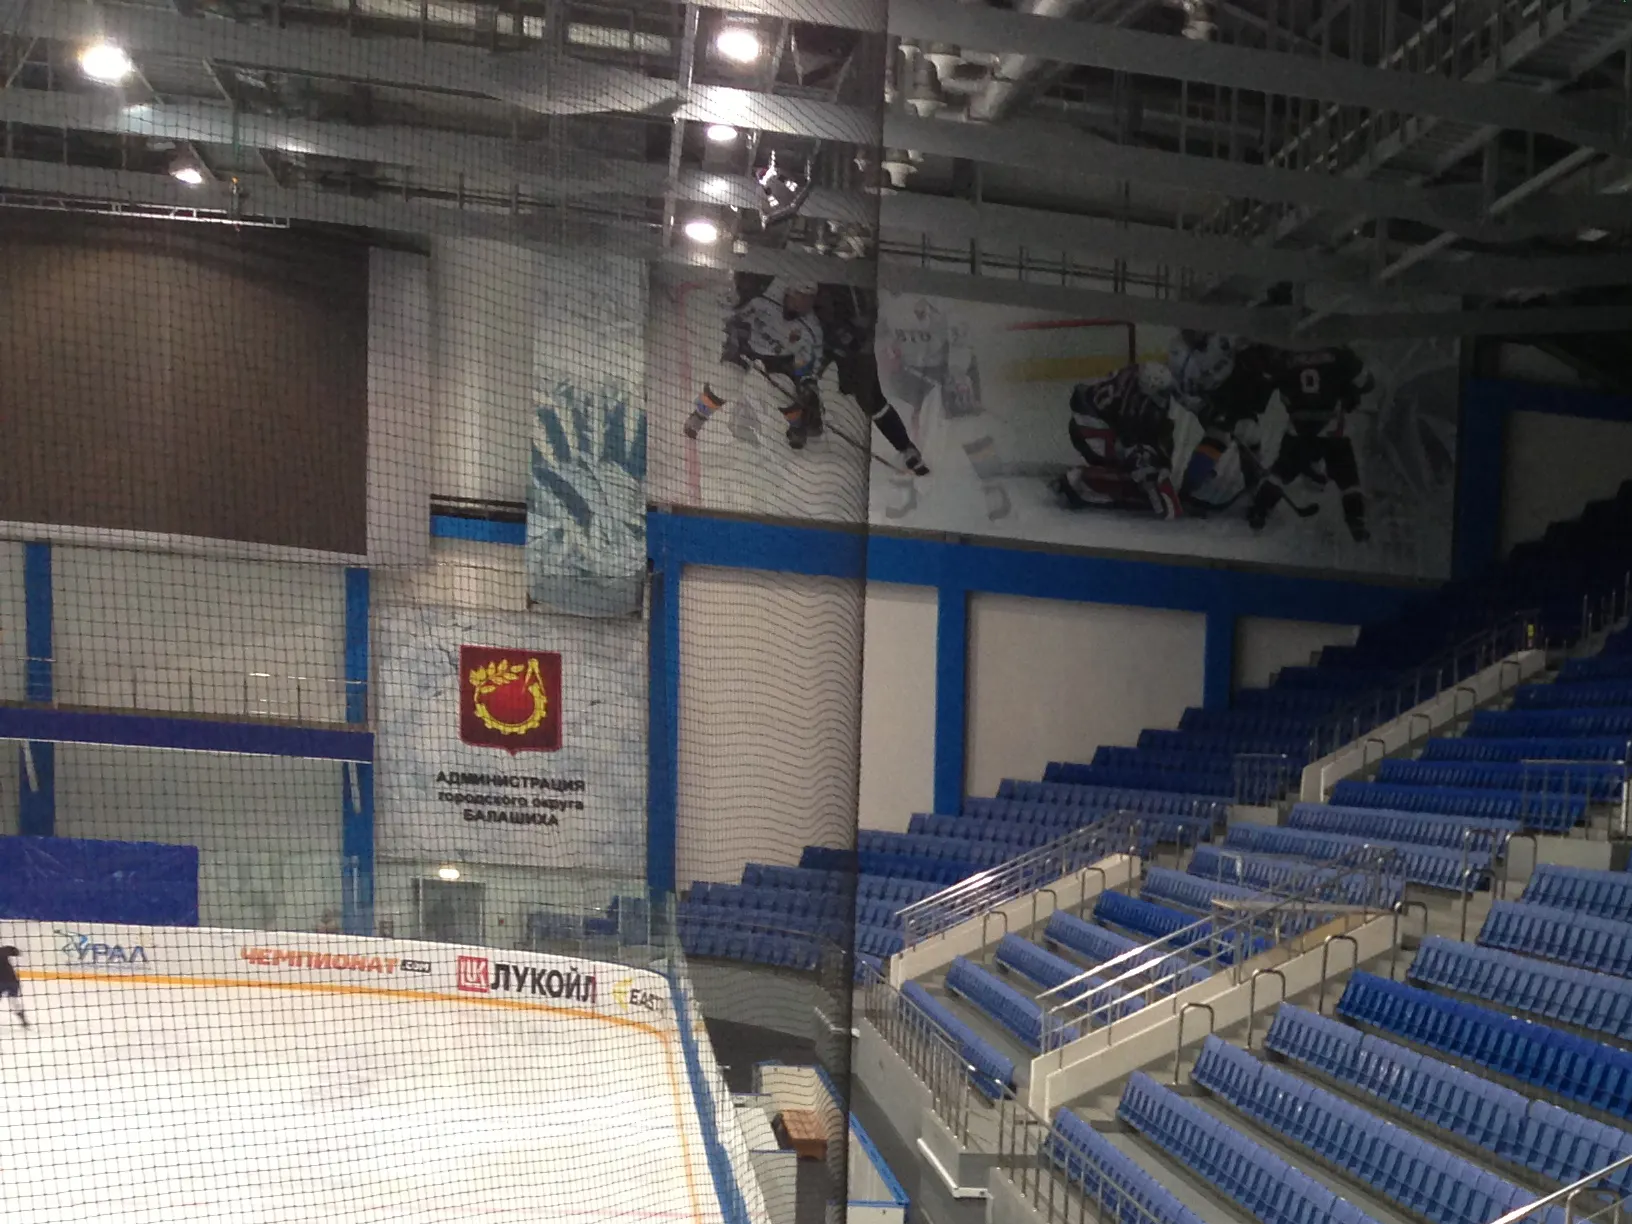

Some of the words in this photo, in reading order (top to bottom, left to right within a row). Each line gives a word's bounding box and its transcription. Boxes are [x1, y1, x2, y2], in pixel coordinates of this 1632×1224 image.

[436, 770, 586, 792] АДМИНИСТРАЦИЯ
[438, 791, 528, 808] городского
[532, 797, 585, 812] округа
[463, 808, 559, 826] БАЛАШИХА
[240, 946, 399, 975] ЧЕМПИОНАТ
[491, 963, 597, 1004] ЛУКОЙЛ
